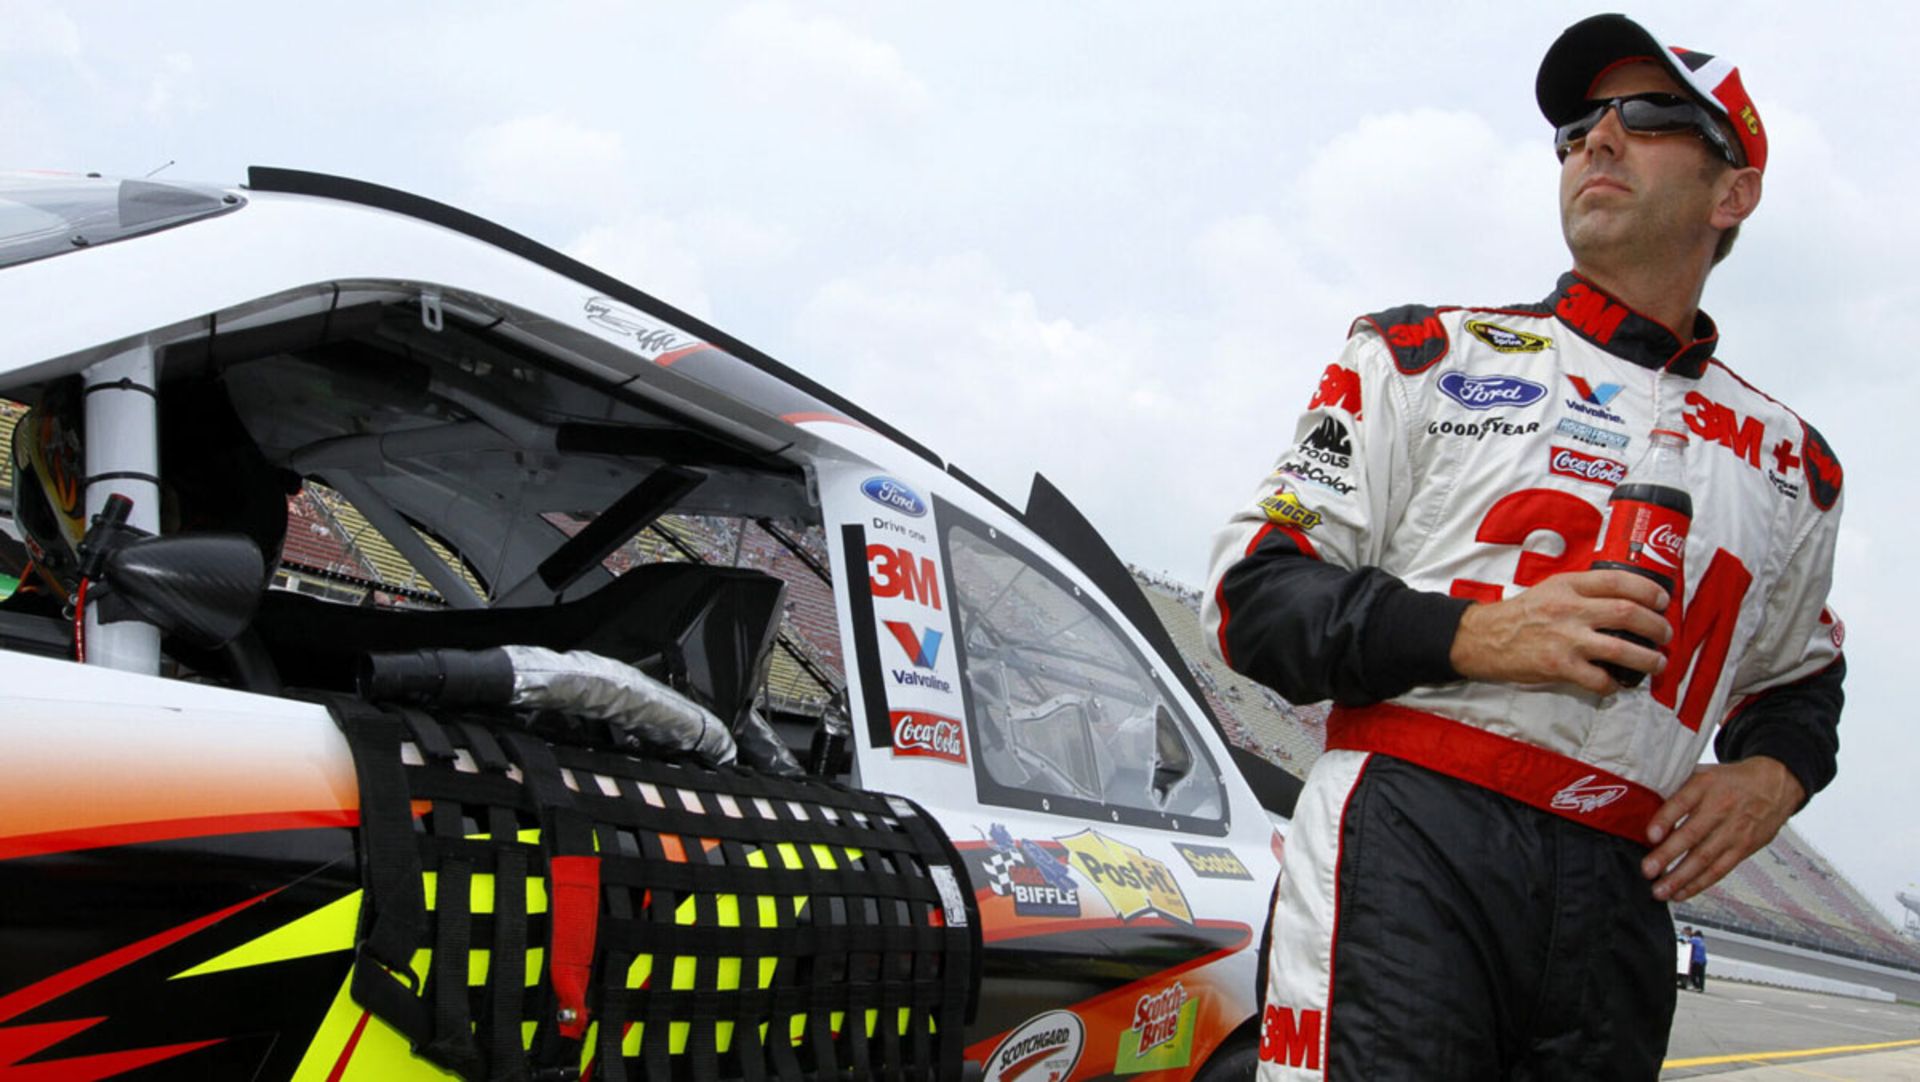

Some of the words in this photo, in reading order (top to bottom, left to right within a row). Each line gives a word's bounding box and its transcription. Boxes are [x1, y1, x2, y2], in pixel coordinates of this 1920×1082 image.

[1555, 282, 1629, 345] 3M
[1387, 316, 1445, 348] 3M
[1460, 379, 1523, 403] Ford
[1566, 399, 1622, 423] Valvoline
[1682, 391, 1765, 470] 3M
[1299, 445, 1350, 469] TOOLS
[1553, 450, 1624, 483] Coca-Cola
[878, 480, 917, 512] Ford
[872, 517, 907, 535] Drive
[908, 529, 927, 543] one
[866, 543, 942, 611] 3M
[892, 669, 951, 694] Valvoline
[894, 715, 961, 756] Coca-Cola
[1075, 851, 1176, 895] Post-it
[1183, 847, 1247, 875] Scotch
[1015, 885, 1078, 905] BIFFLE
[999, 1027, 1070, 1071] SCOTCHGARD
[1139, 1014, 1178, 1055] Brite
[1258, 1004, 1322, 1070] 3M
